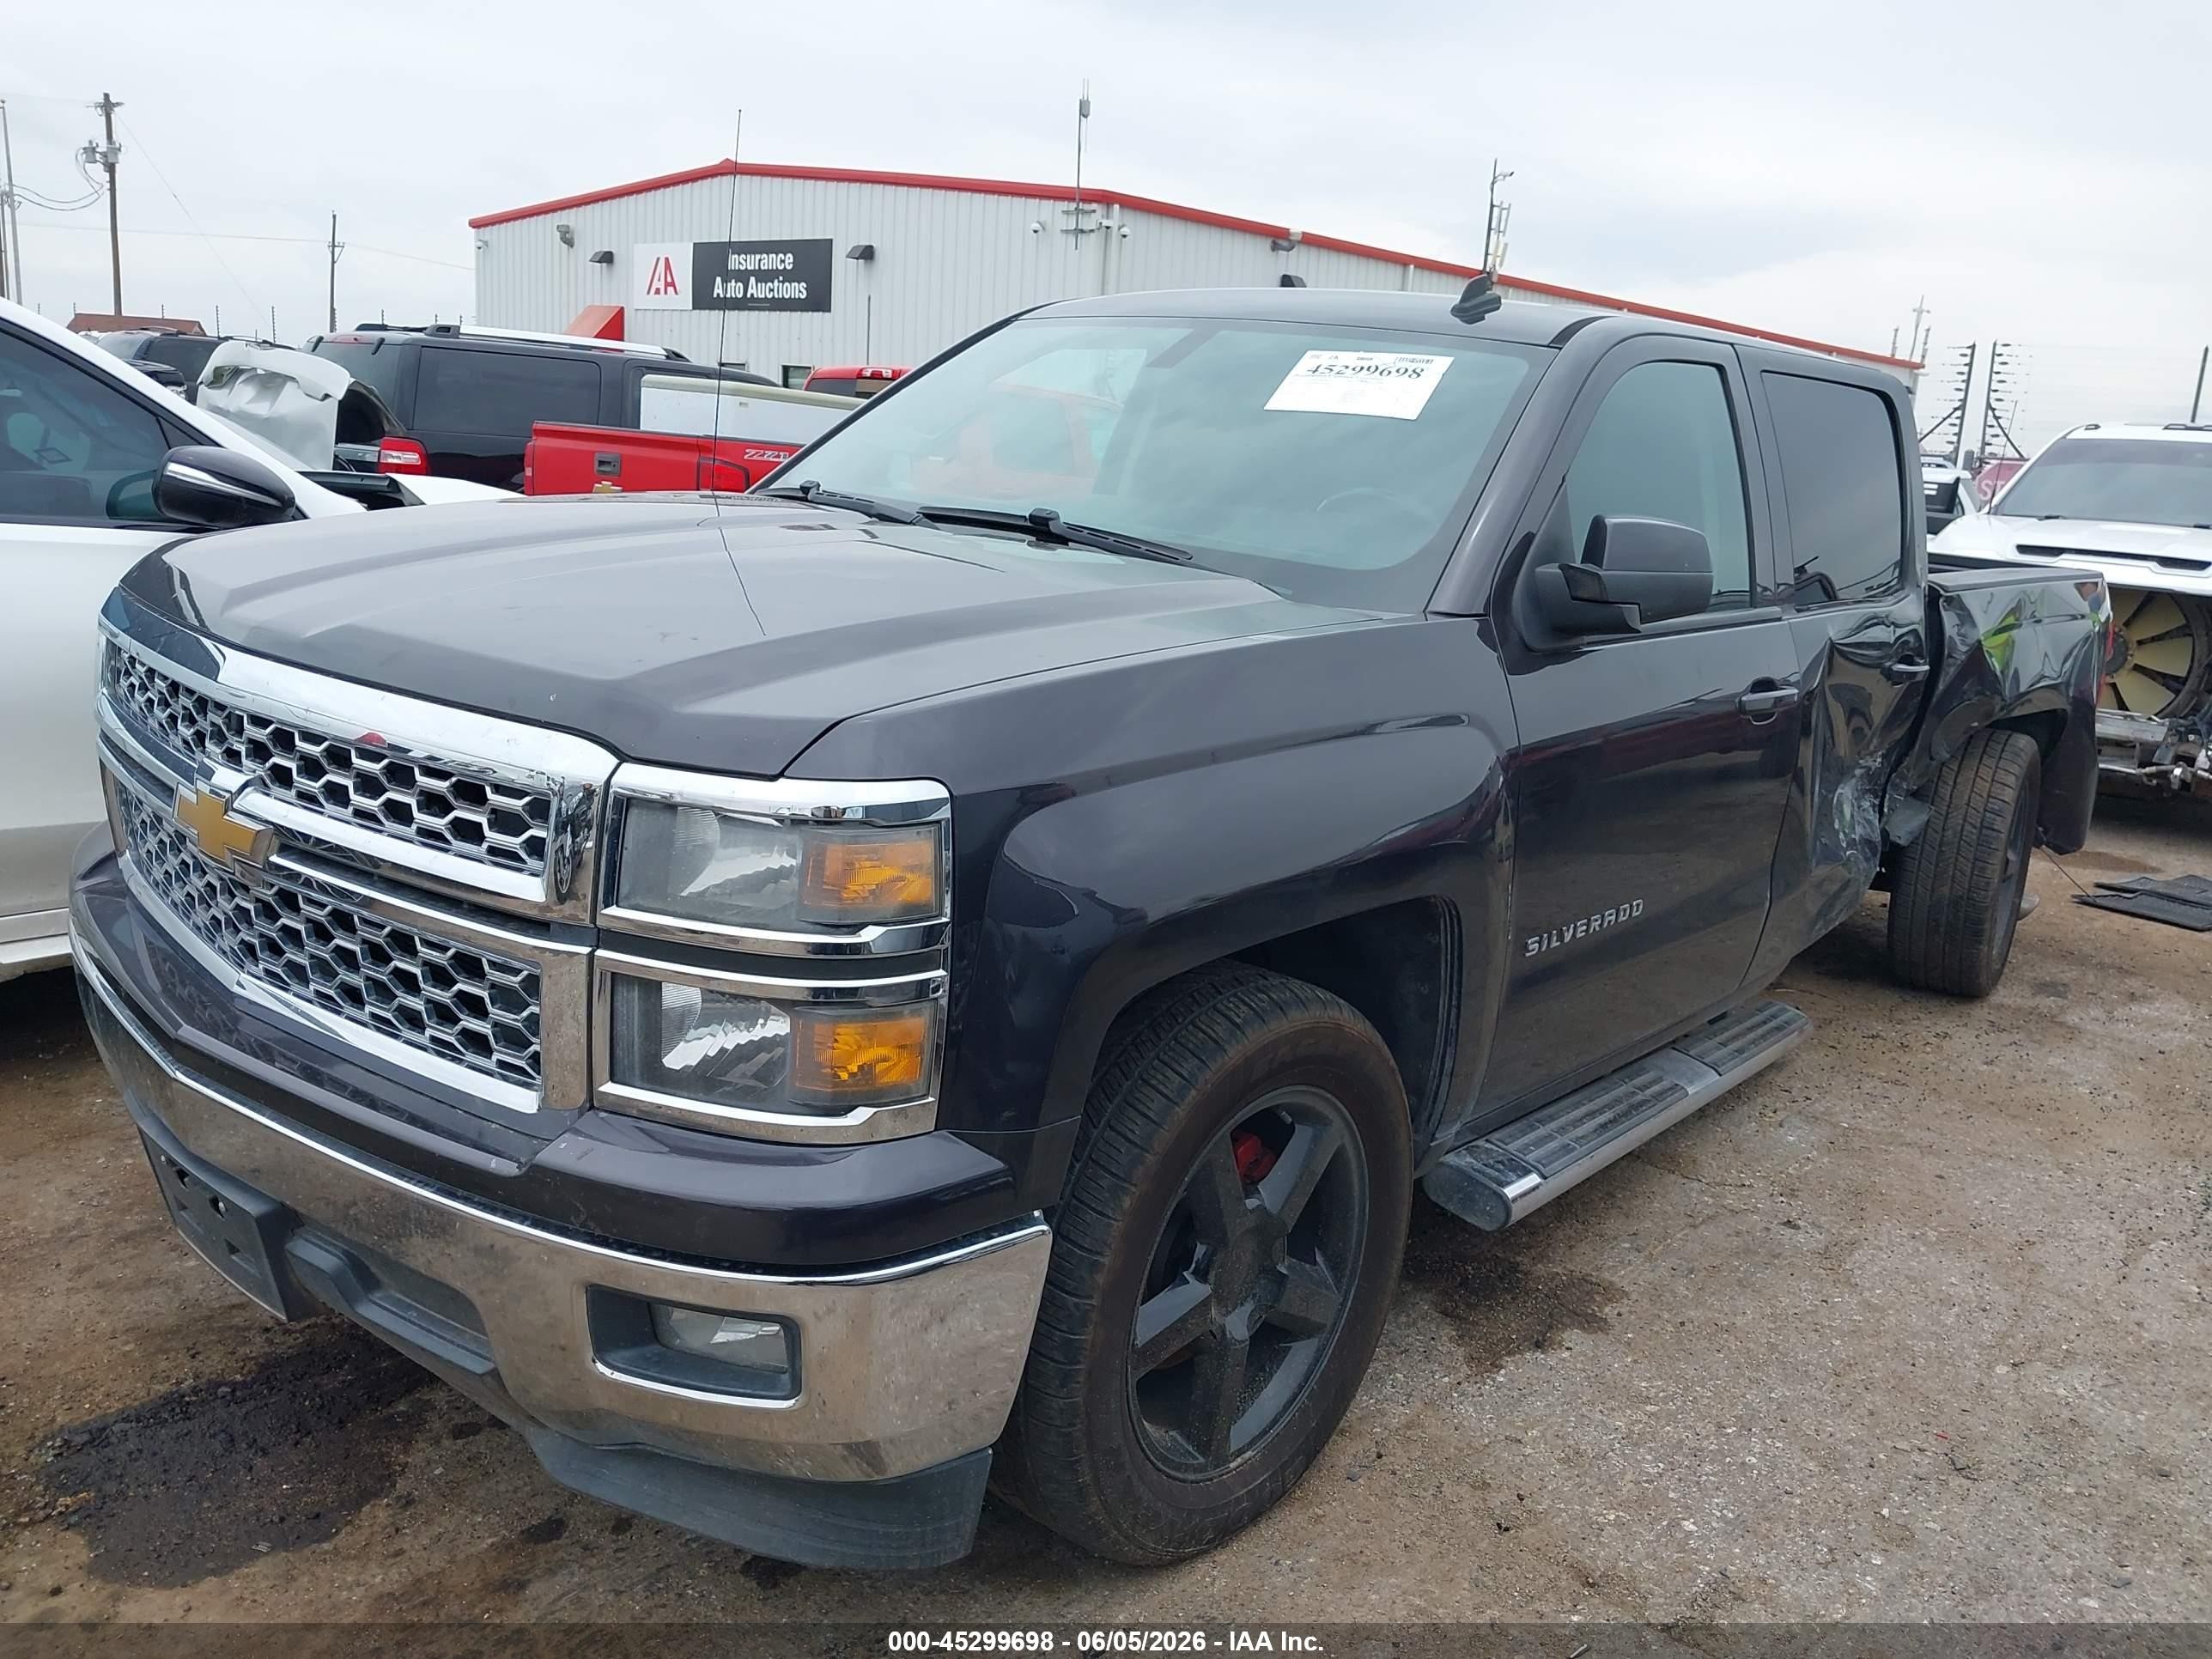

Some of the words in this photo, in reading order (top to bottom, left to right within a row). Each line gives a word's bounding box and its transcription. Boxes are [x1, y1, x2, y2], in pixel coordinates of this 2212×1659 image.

[727, 249, 794, 270] Insurance
[713, 276, 744, 299] Auto
[747, 276, 807, 300] Auctions
[1306, 363, 1425, 380] 45299698
[1978, 479, 2006, 501] ST
[1524, 898, 1644, 957] SILVERADO
